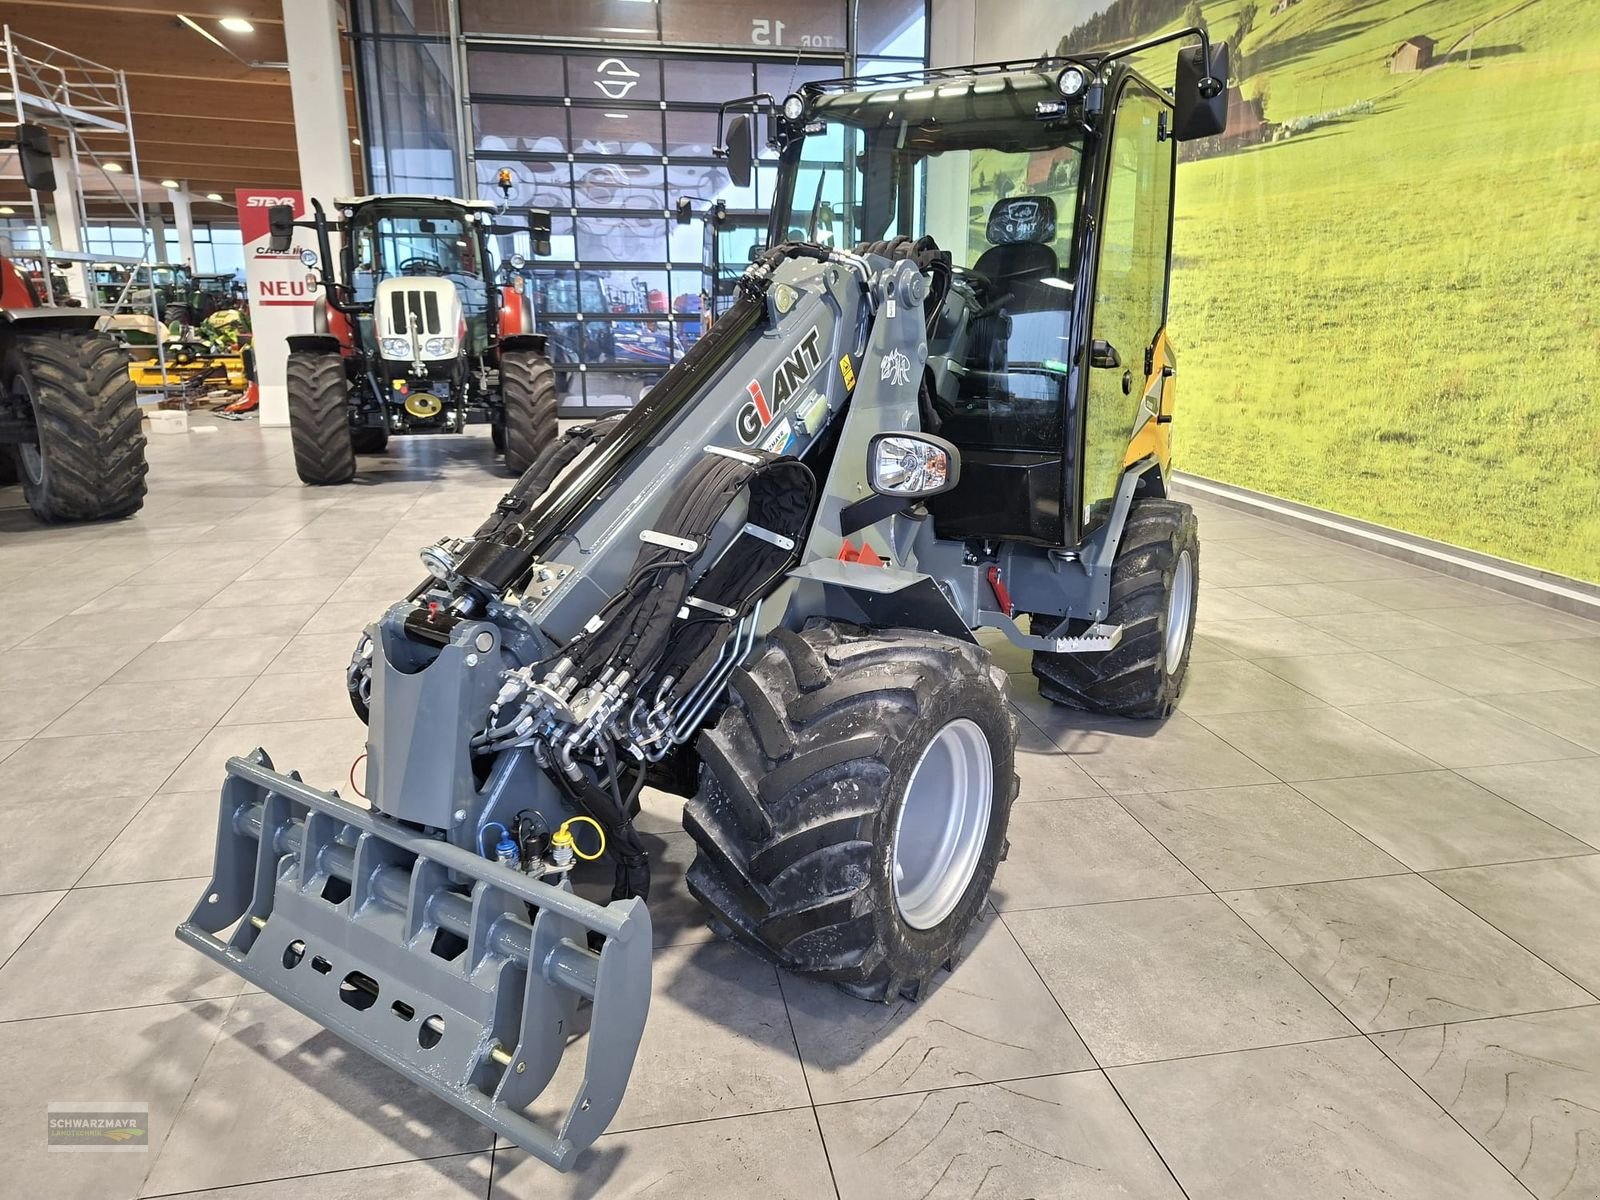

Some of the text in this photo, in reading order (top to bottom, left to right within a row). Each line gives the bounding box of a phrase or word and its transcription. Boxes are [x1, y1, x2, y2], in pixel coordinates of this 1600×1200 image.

[246, 196, 296, 208] STEYR
[1005, 222, 1037, 233] GANT
[260, 281, 305, 296] NEU
[736, 325, 822, 446] GIANT
